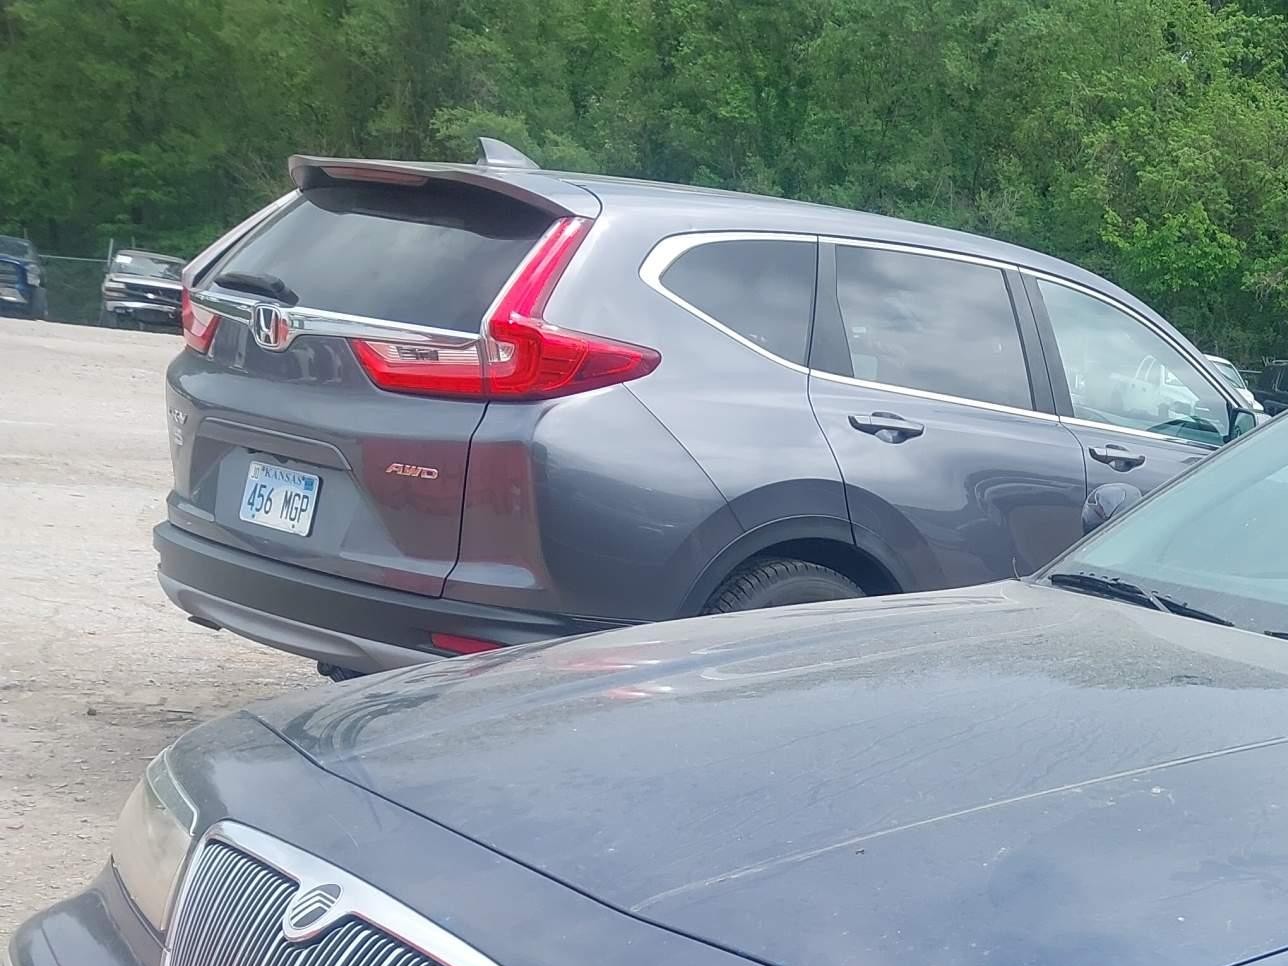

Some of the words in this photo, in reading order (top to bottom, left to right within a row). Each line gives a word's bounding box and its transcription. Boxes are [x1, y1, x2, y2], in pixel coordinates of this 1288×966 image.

[264, 466, 303, 487] KANSAS
[385, 463, 439, 480] AWD
[247, 483, 274, 514] 456
[280, 490, 310, 523] MGP
